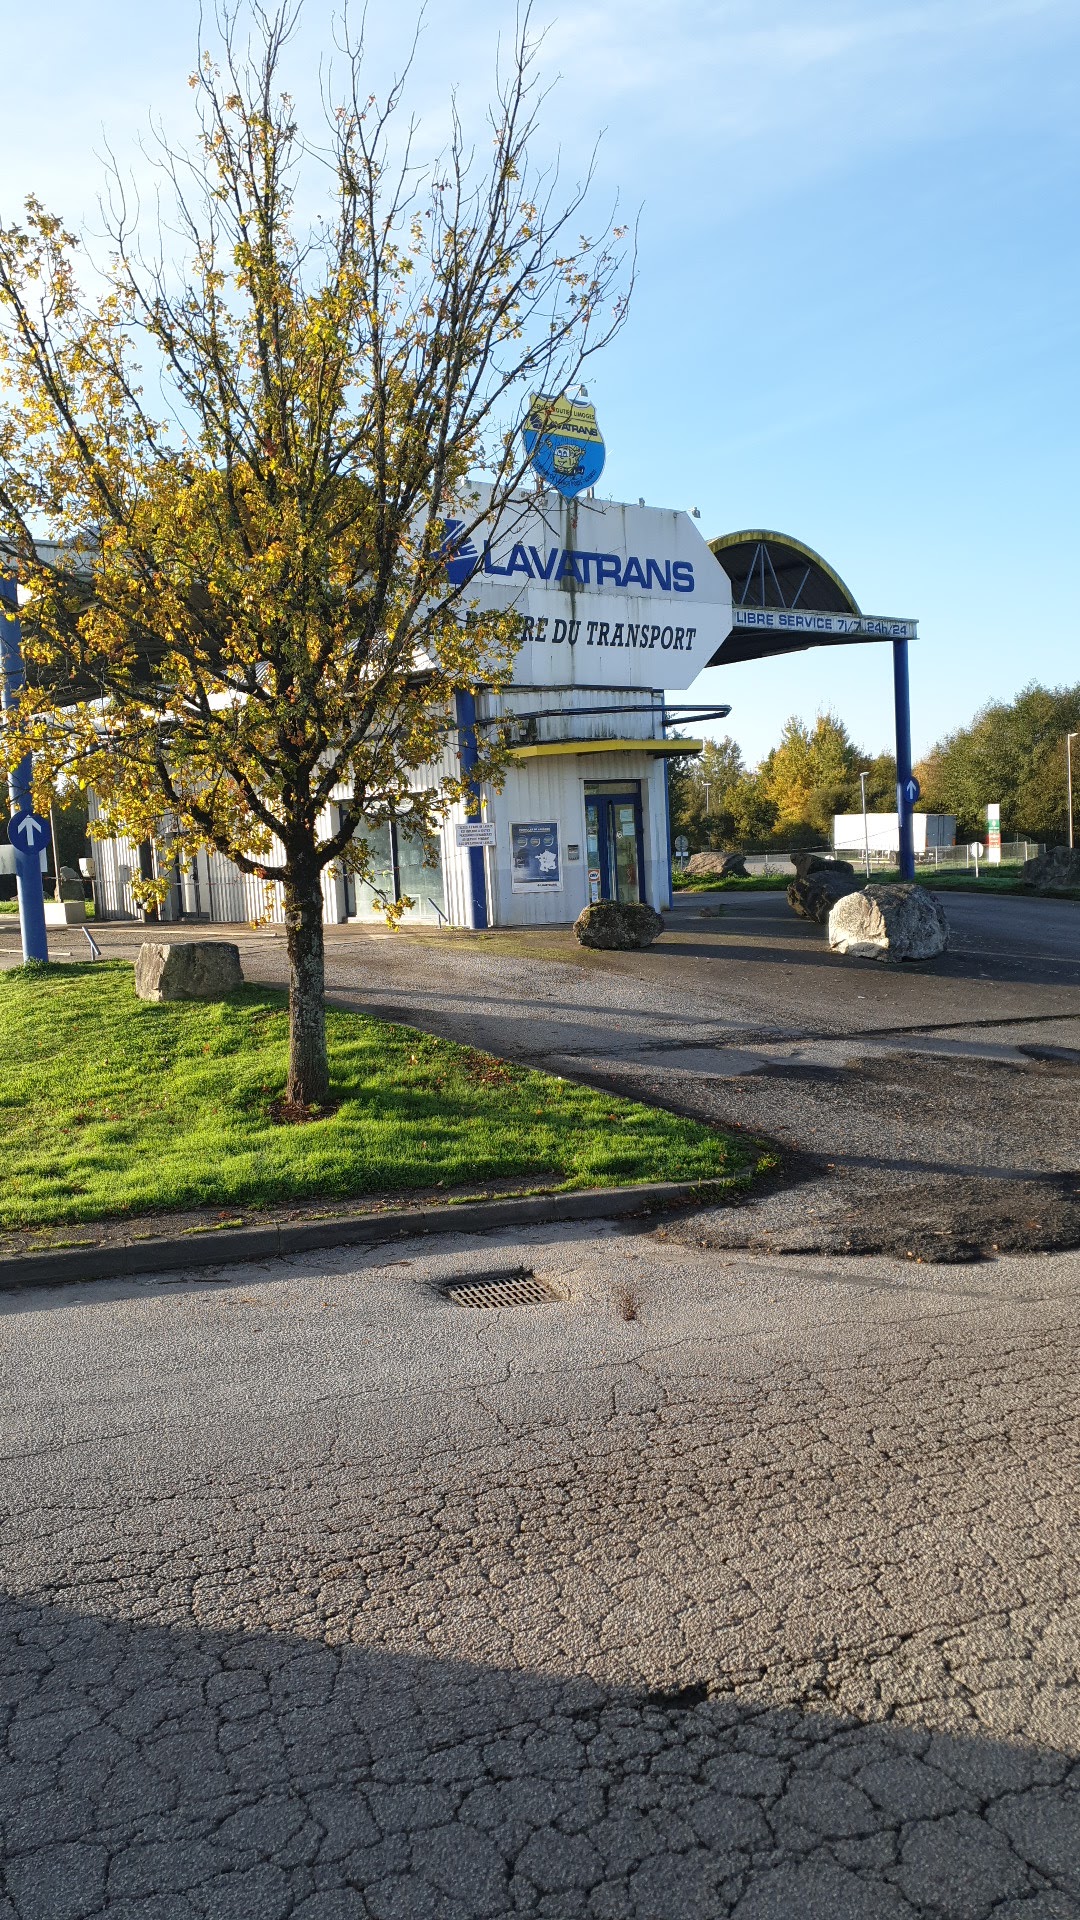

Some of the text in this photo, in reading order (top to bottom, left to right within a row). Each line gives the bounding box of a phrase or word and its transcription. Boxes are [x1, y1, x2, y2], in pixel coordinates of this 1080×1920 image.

[484, 539, 695, 593] LAVATRANS
[551, 618, 582, 646] DU
[586, 620, 697, 650] TRANSPORT
[736, 611, 774, 626] LIBRE
[778, 614, 833, 630] SERVICE
[867, 621, 907, 636] 24h/24
